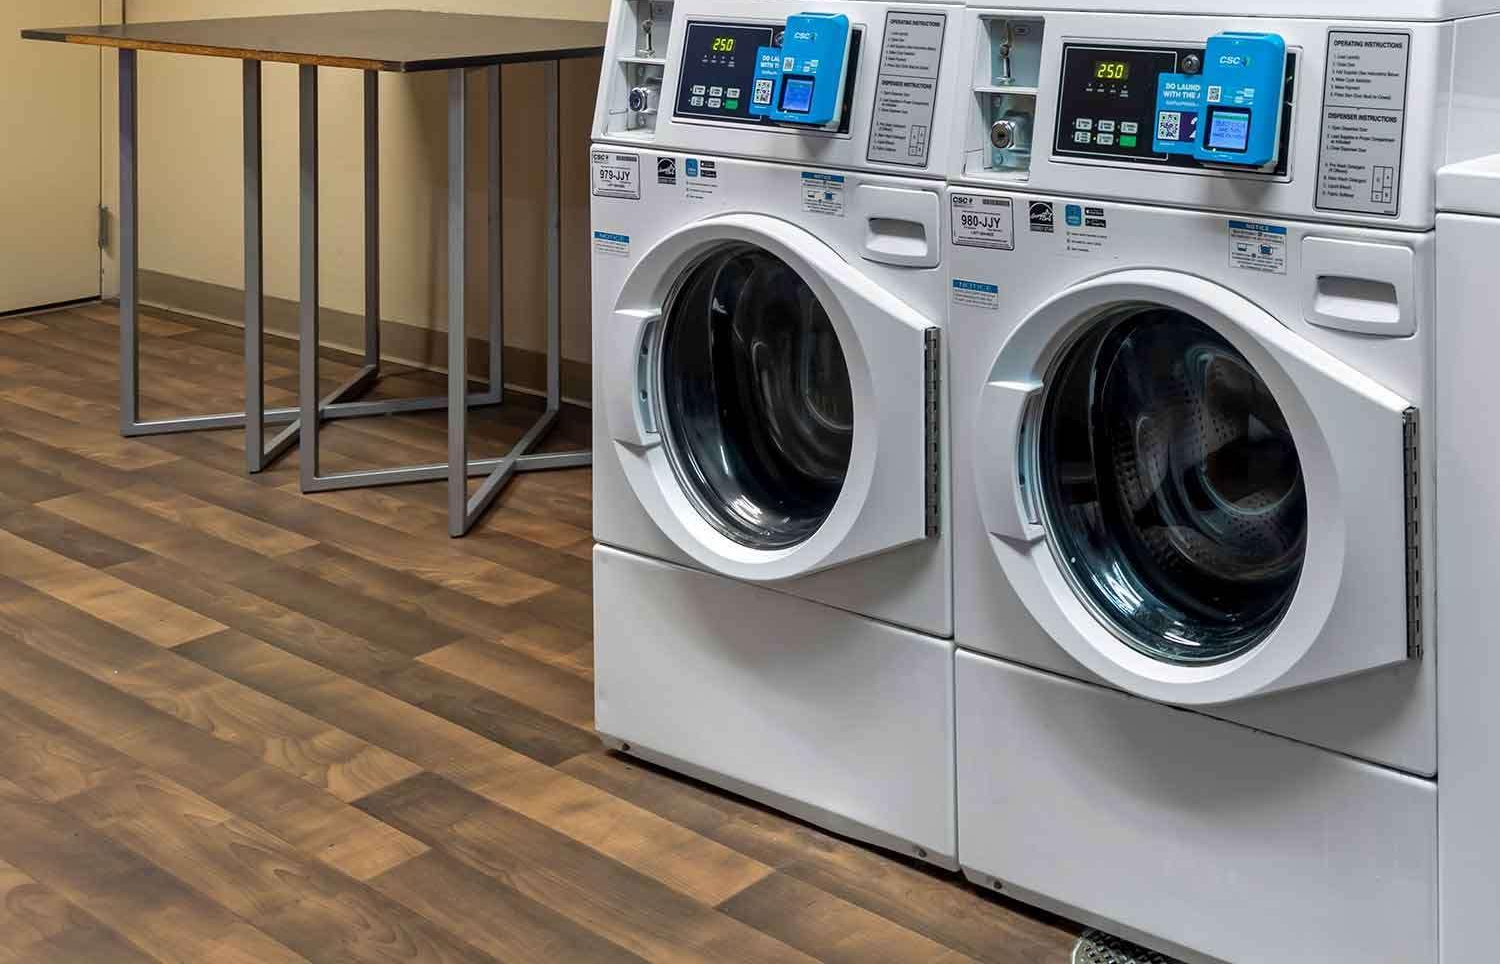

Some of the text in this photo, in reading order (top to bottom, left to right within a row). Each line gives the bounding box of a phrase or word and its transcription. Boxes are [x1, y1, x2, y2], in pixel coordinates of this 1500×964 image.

[1364, 41, 1402, 49] INSTRUCTIONS
[1220, 56, 1240, 65] CSC
[1097, 64, 1124, 78] 250
[1358, 115, 1397, 123] INSTRUCTIONS
[600, 169, 630, 180] 979-JJY
[953, 196, 968, 204] CSC
[961, 215, 1000, 228] 980-JJY
